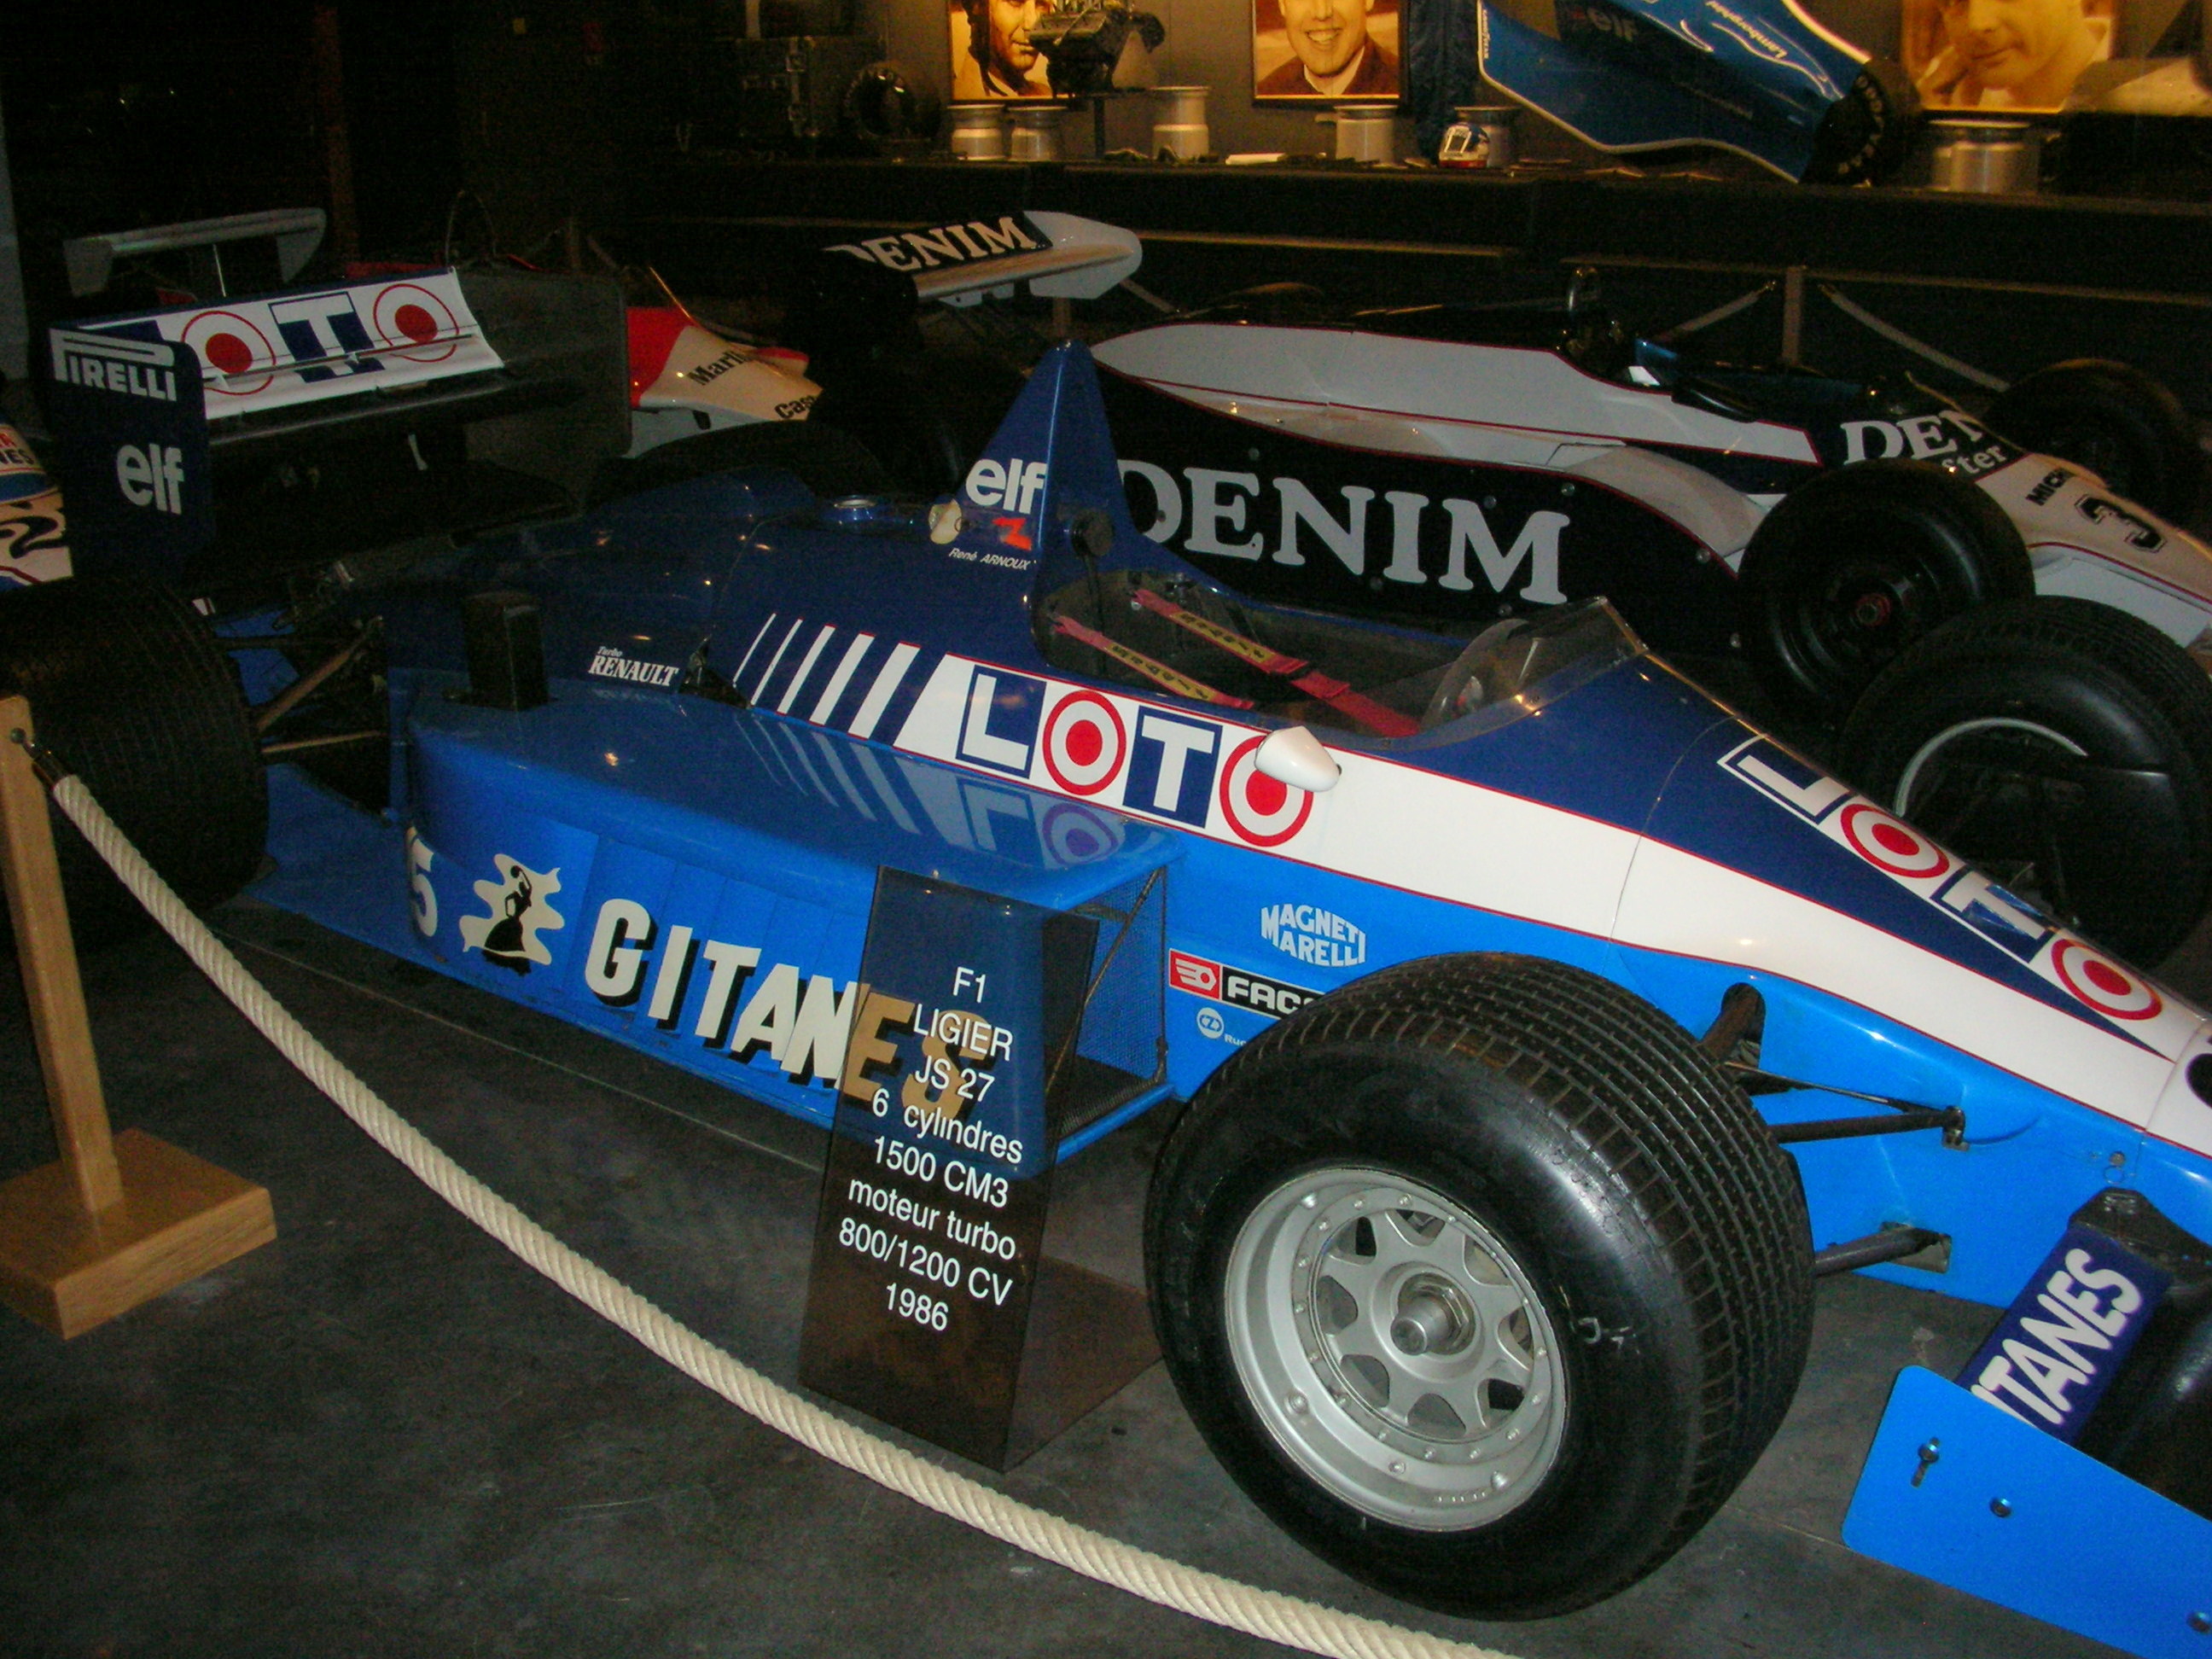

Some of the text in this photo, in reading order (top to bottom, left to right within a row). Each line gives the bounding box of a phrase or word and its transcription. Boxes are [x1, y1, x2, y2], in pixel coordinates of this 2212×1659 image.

[49, 328, 177, 402] PIRELLI
[178, 283, 460, 395] OTO
[116, 444, 184, 515] elf
[965, 457, 1048, 514] elf
[949, 547, 1031, 571] René ARNOUX
[1115, 459, 1570, 602] DENIM
[588, 655, 679, 686] RENAULT
[597, 646, 623, 657] Turbo
[956, 665, 1314, 847] LOTO
[1718, 735, 2163, 1021] LOTO
[1260, 903, 1366, 951] MAGNETI
[585, 899, 995, 1121] GITANES
[952, 966, 987, 1004] F1
[1227, 976, 1316, 1016] FAC
[913, 1003, 1014, 1062] LIGIER
[915, 1055, 996, 1103] JS 27
[871, 1087, 1023, 1165] 6 cylindres
[873, 1135, 1010, 1209] 1500 CM3
[847, 1179, 1016, 1260] moteur turbo
[838, 1217, 1014, 1307] 800/1200 CV
[886, 1282, 949, 1331] 1986
